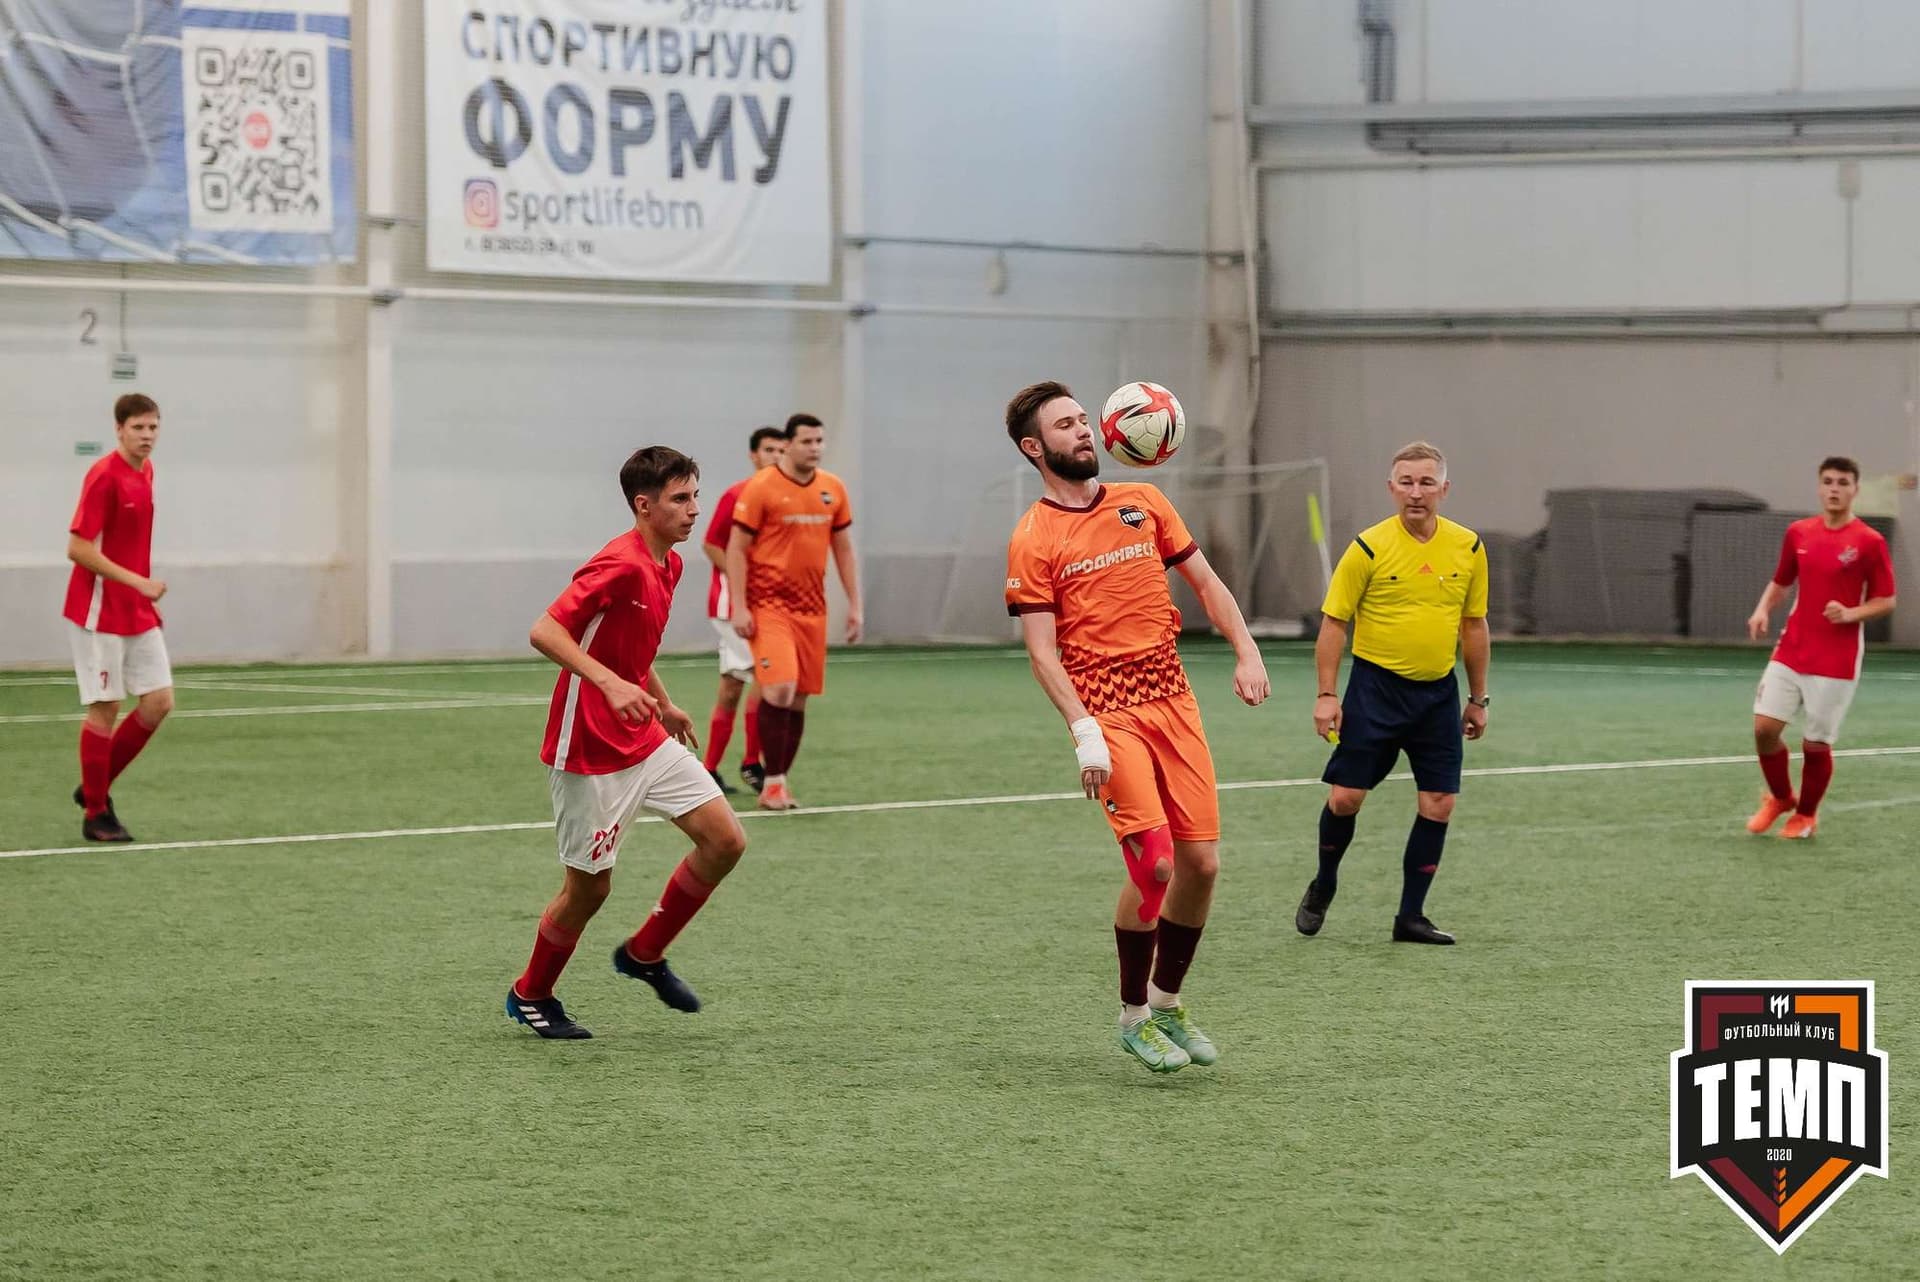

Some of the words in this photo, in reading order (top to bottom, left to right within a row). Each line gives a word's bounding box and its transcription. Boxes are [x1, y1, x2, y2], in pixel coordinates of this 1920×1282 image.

[461, 12, 795, 80] СПОРТИВНУЮ
[463, 76, 792, 185] ФОРМУ
[504, 187, 705, 232] sportlifebrn
[79, 308, 98, 344] 2
[100, 671, 109, 690] 7
